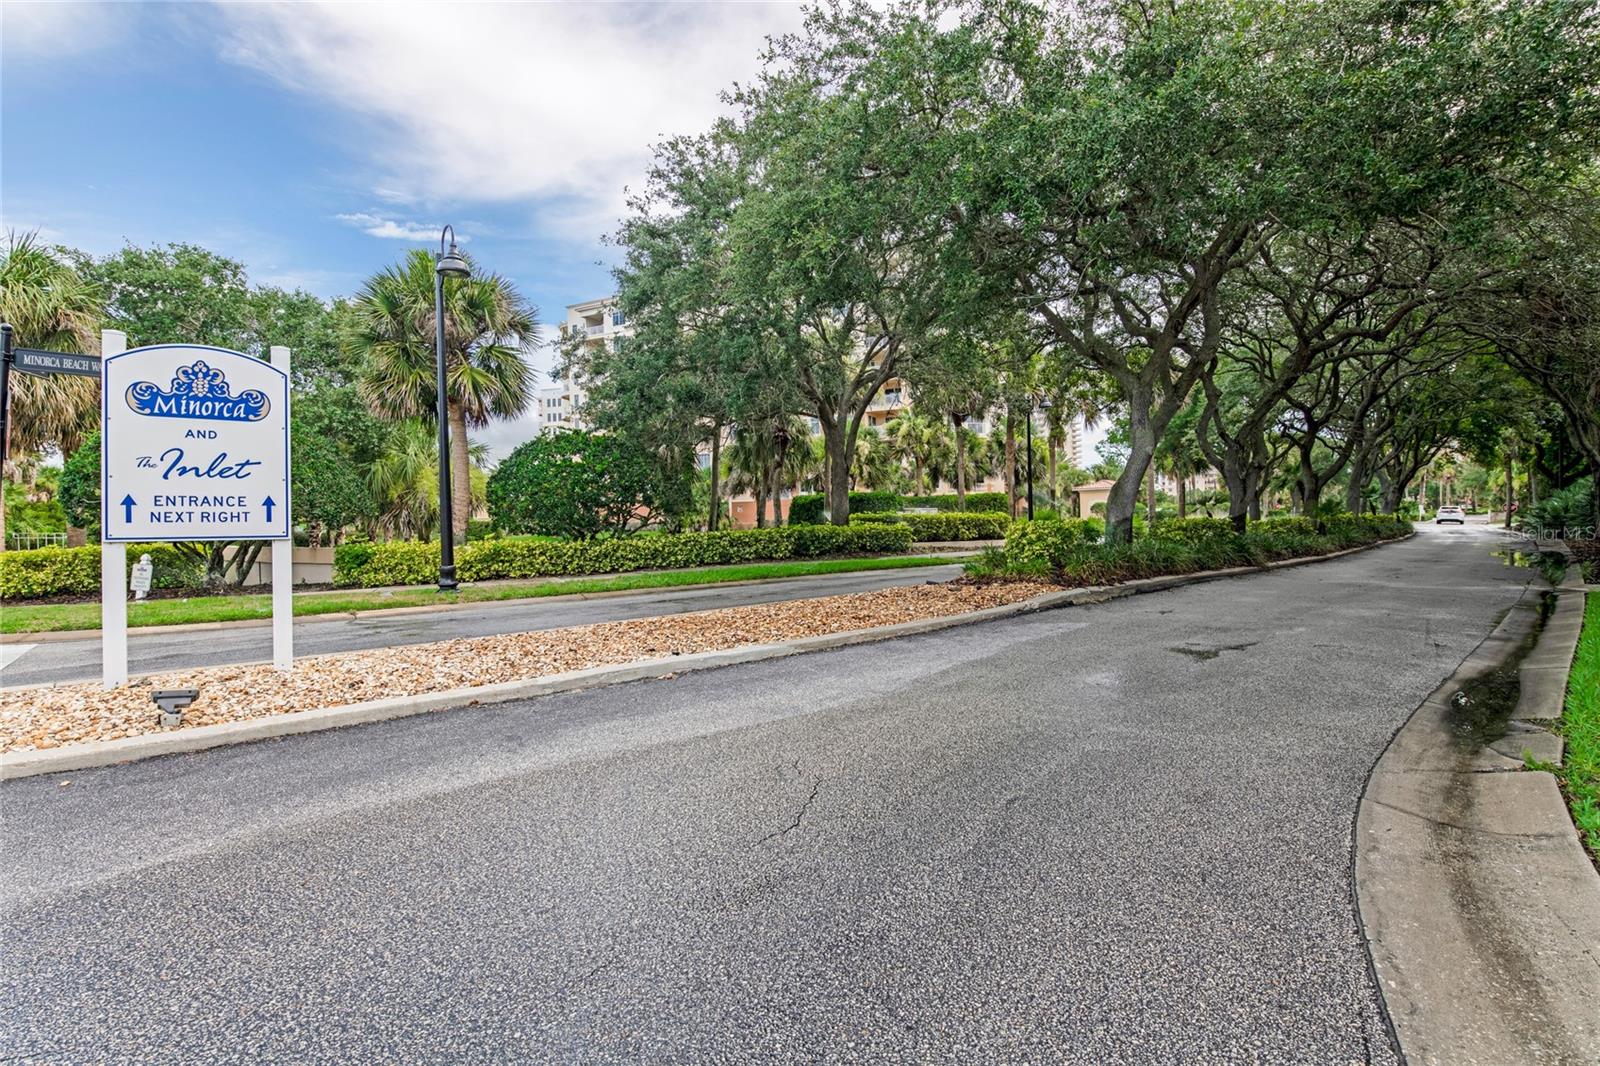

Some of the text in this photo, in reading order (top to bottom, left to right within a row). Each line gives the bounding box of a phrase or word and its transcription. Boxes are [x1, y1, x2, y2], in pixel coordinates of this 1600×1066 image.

[23, 354, 60, 368] MINORCA
[63, 358, 89, 371] BEACH
[153, 396, 247, 419] Minorca
[184, 429, 217, 440] AND
[135, 447, 262, 480] The Inlet
[153, 495, 247, 507] ENTRANCE
[150, 511, 251, 523] NEXT RIGHT
